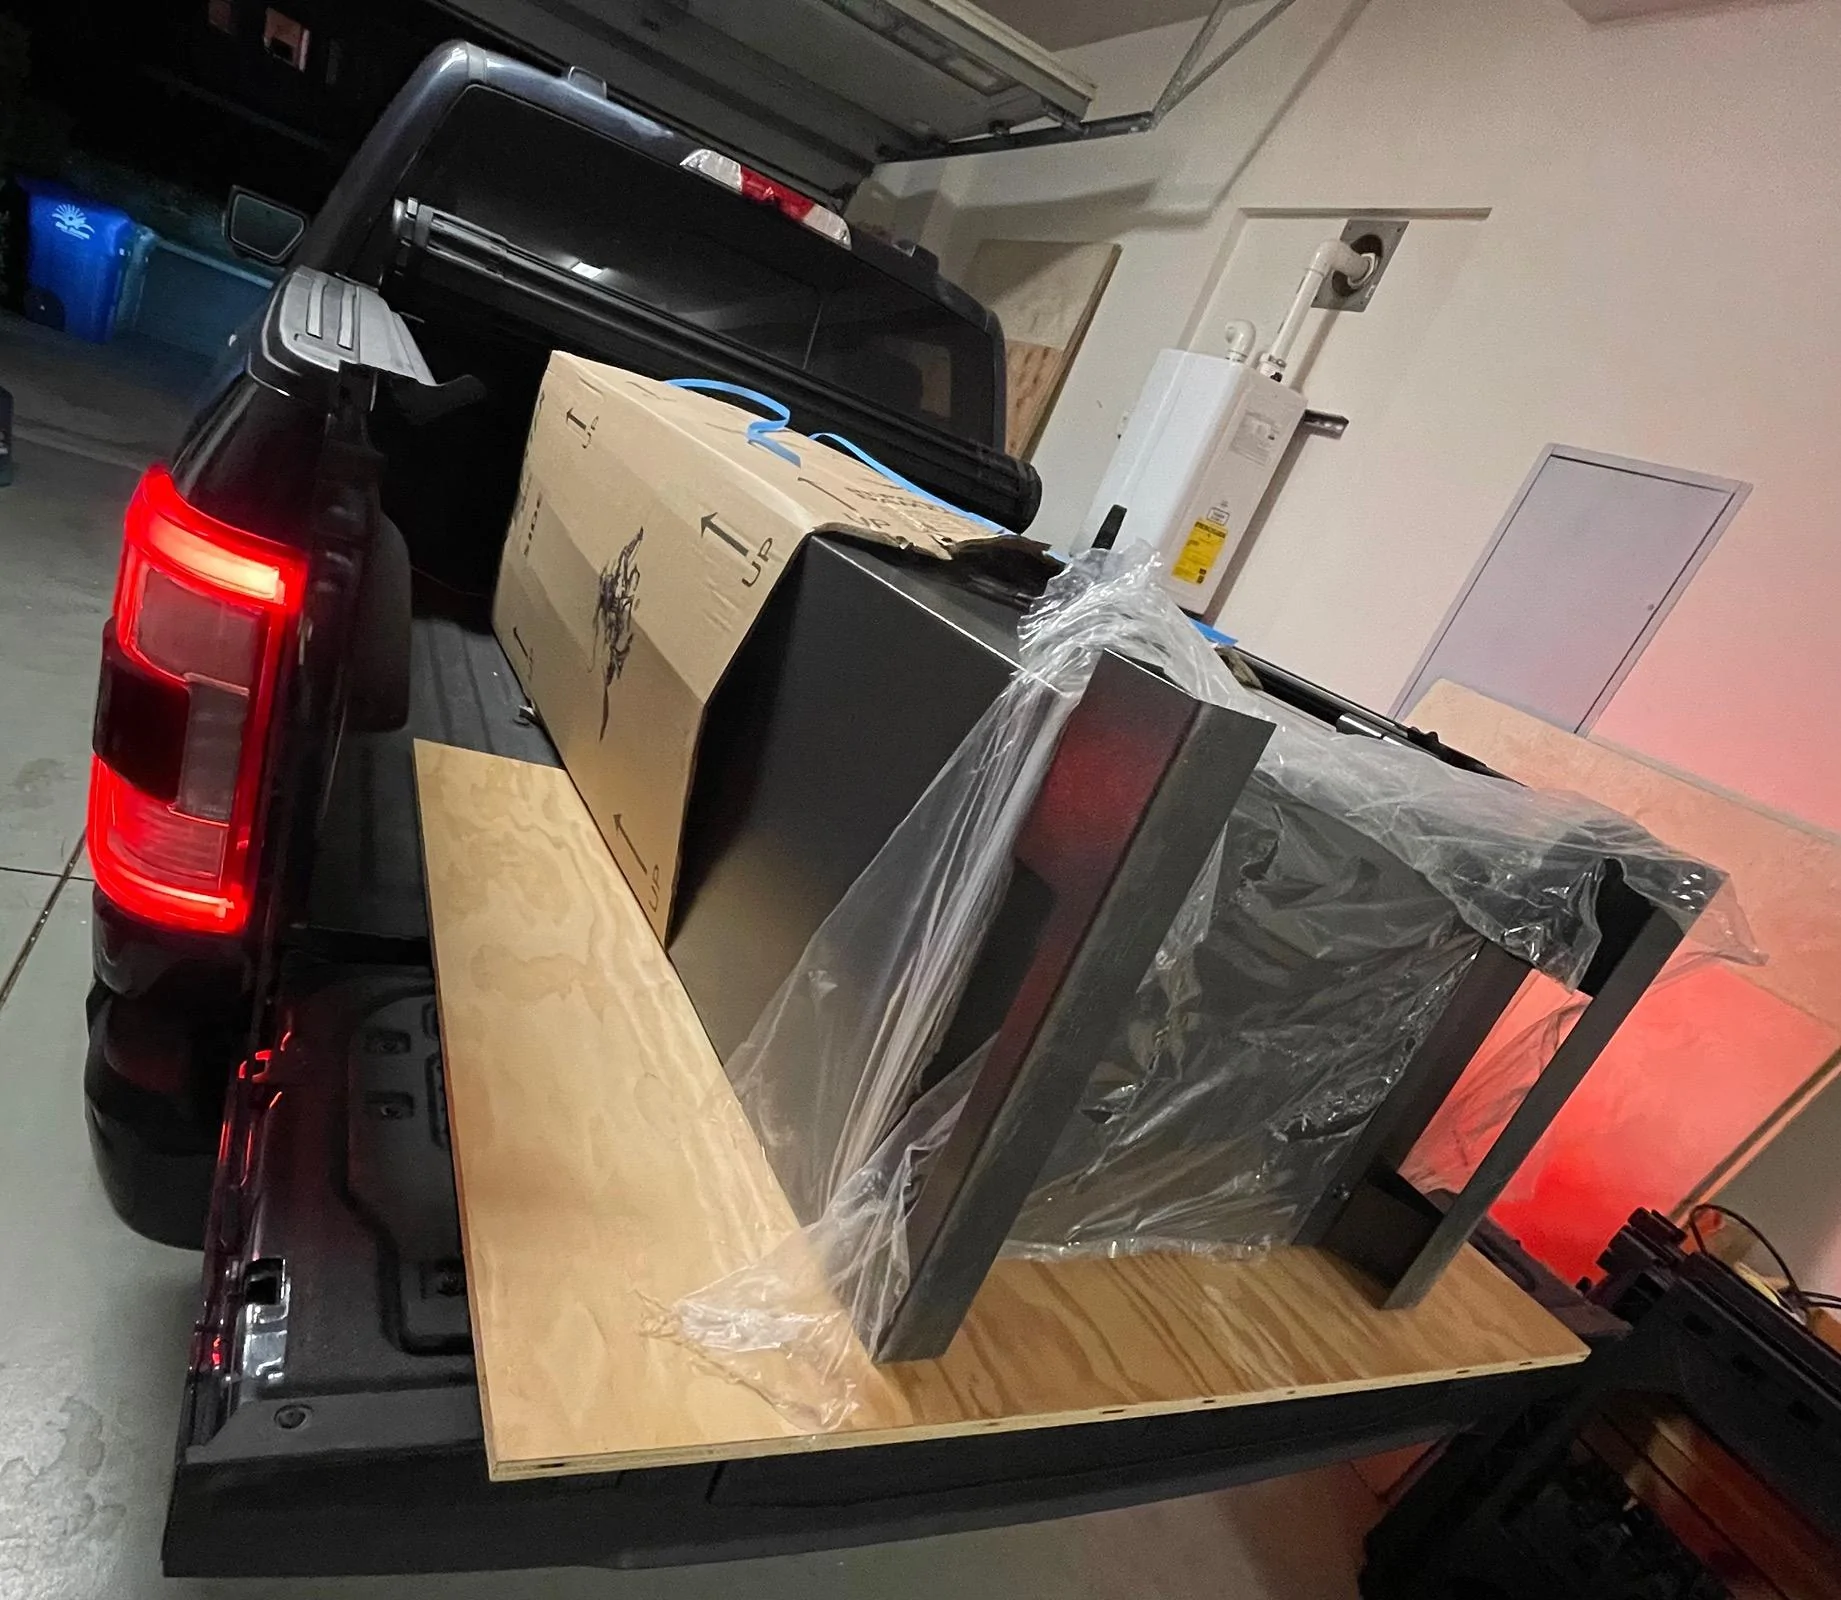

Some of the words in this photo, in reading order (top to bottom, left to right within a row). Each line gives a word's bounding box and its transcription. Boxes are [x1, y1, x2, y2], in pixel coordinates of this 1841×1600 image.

[843, 512, 891, 529] UP
[741, 537, 773, 588] UP
[648, 864, 660, 913] UP
